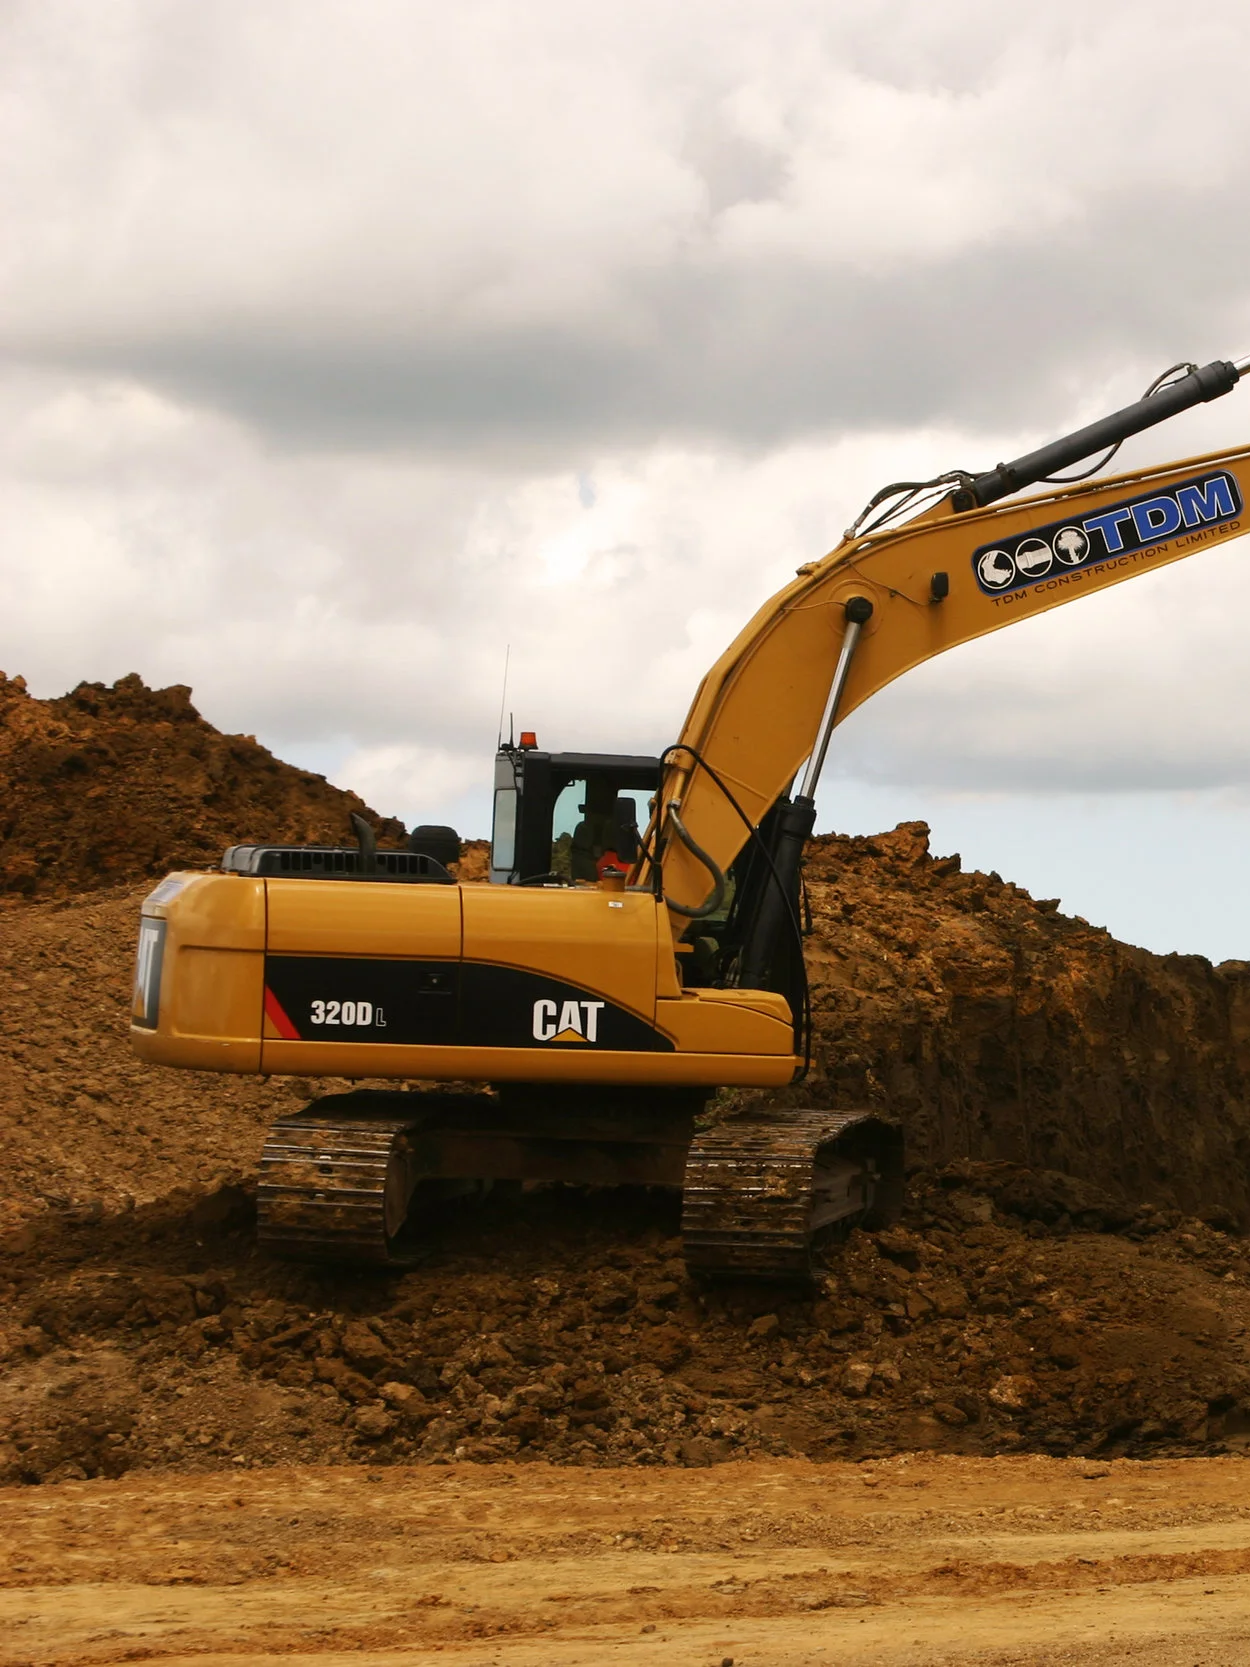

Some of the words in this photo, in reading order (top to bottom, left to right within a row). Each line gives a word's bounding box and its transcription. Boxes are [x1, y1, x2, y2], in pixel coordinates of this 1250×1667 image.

[1082, 475, 1236, 553] TDM
[993, 592, 1028, 607] TDM
[1034, 546, 1169, 594] CONSTRUCTION
[1174, 521, 1241, 549] LIMITED
[310, 1000, 373, 1026] 320D
[532, 999, 605, 1042] CAT
